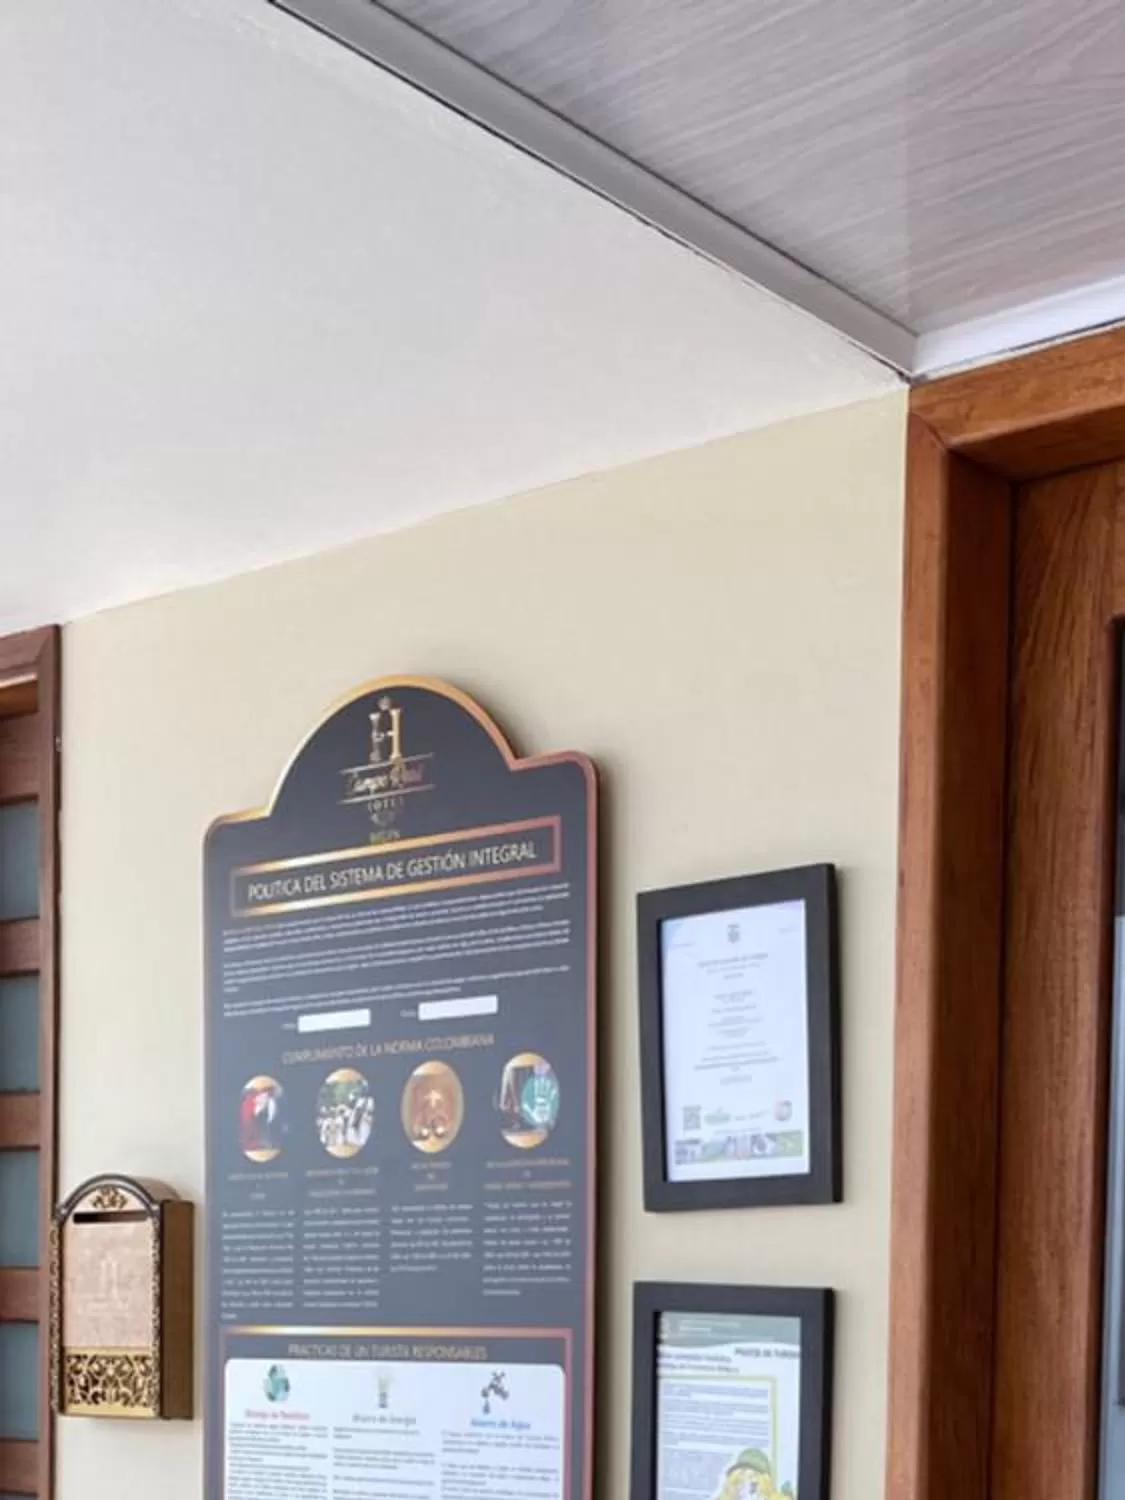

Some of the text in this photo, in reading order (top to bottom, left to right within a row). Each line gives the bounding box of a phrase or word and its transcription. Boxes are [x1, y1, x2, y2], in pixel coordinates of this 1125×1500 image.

[303, 872, 327, 894] DEL
[329, 863, 384, 890] SISTEMA
[385, 860, 404, 881] DE
[406, 847, 466, 878] GESTIÓN
[467, 839, 537, 868] INTEGRAL
